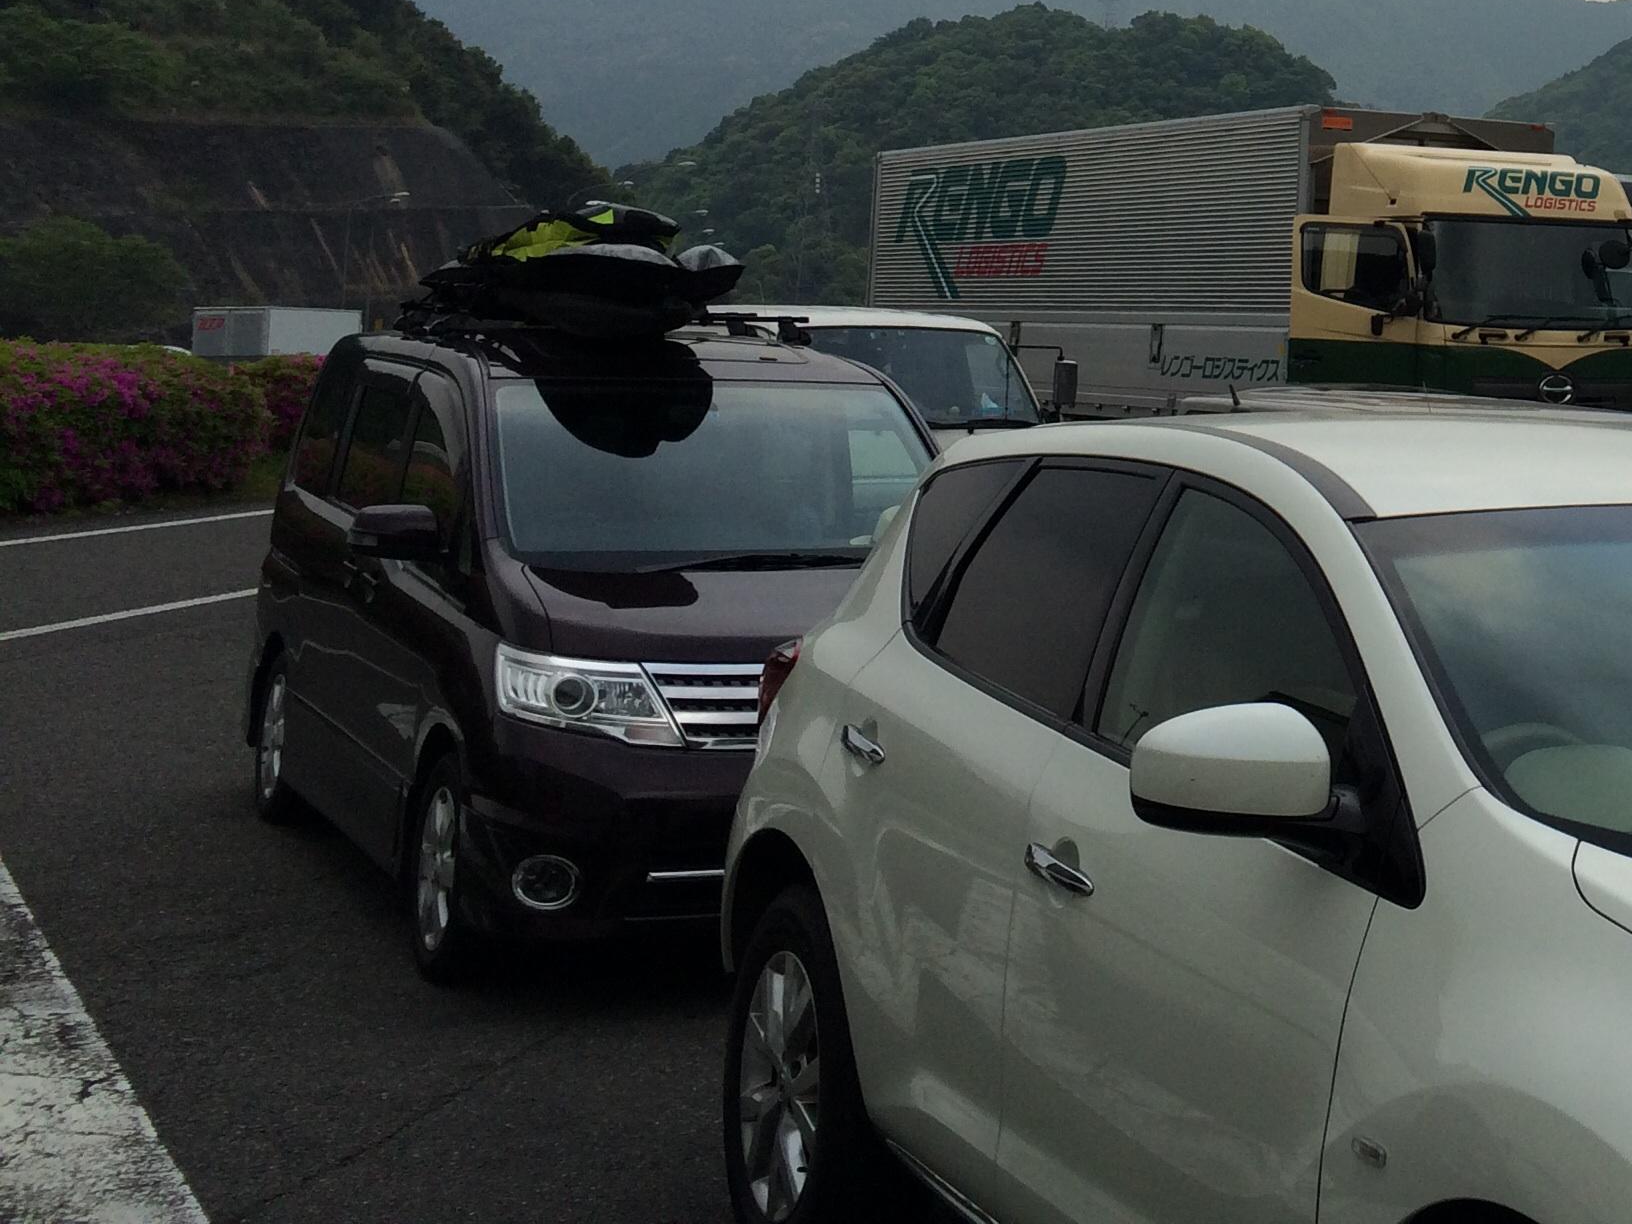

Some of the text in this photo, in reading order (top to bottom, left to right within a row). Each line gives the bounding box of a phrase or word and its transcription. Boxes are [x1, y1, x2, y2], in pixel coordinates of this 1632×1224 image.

[1462, 165, 1601, 217] RENGO
[1524, 196, 1597, 213] LOGISTICS
[895, 155, 1067, 299] RENGO
[952, 242, 1049, 278] LOGISTICS
[1160, 354, 1280, 382] レンゴーロジスティクス
